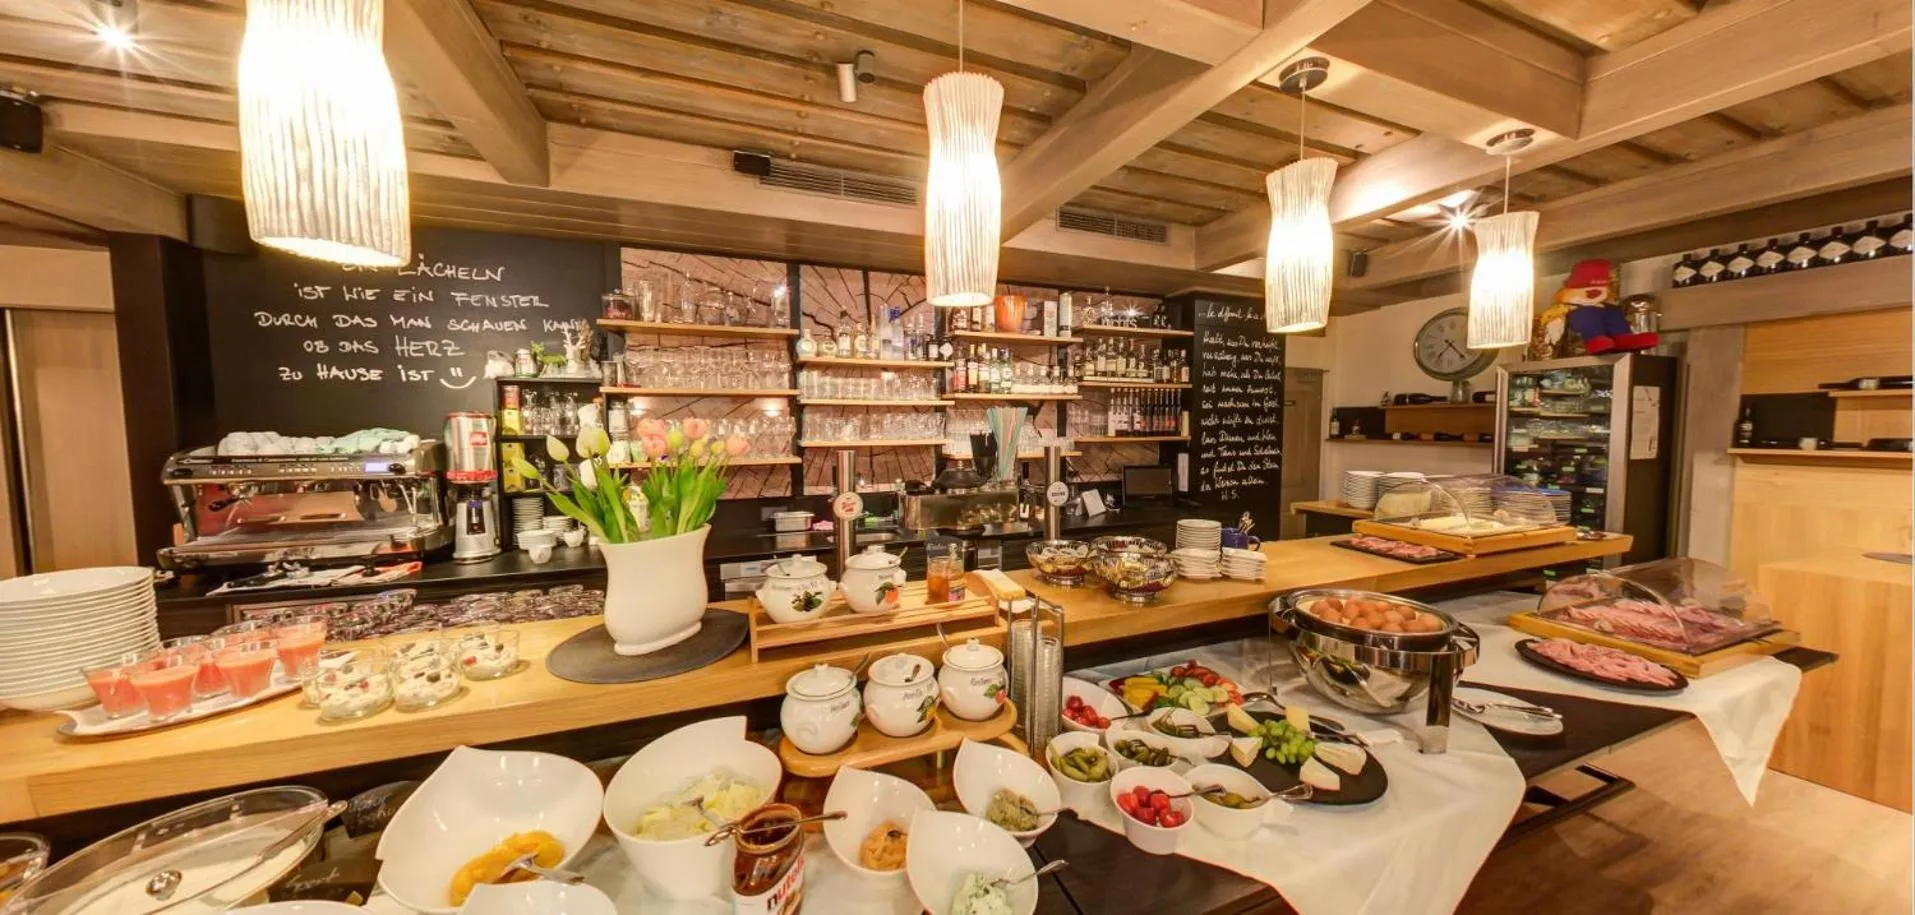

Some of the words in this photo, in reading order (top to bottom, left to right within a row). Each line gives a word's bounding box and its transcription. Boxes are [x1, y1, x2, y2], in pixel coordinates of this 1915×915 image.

[398, 253, 506, 281] LÄCHELN
[450, 291, 549, 308] FENSTER
[254, 311, 318, 328] DURCH
[332, 314, 378, 328] DAS
[389, 314, 432, 329] MAN
[447, 318, 527, 333] SCHAUEN
[303, 340, 330, 353] OB
[339, 340, 379, 354] DAS
[394, 334, 466, 357] HERZ
[316, 363, 383, 381] HAUSE
